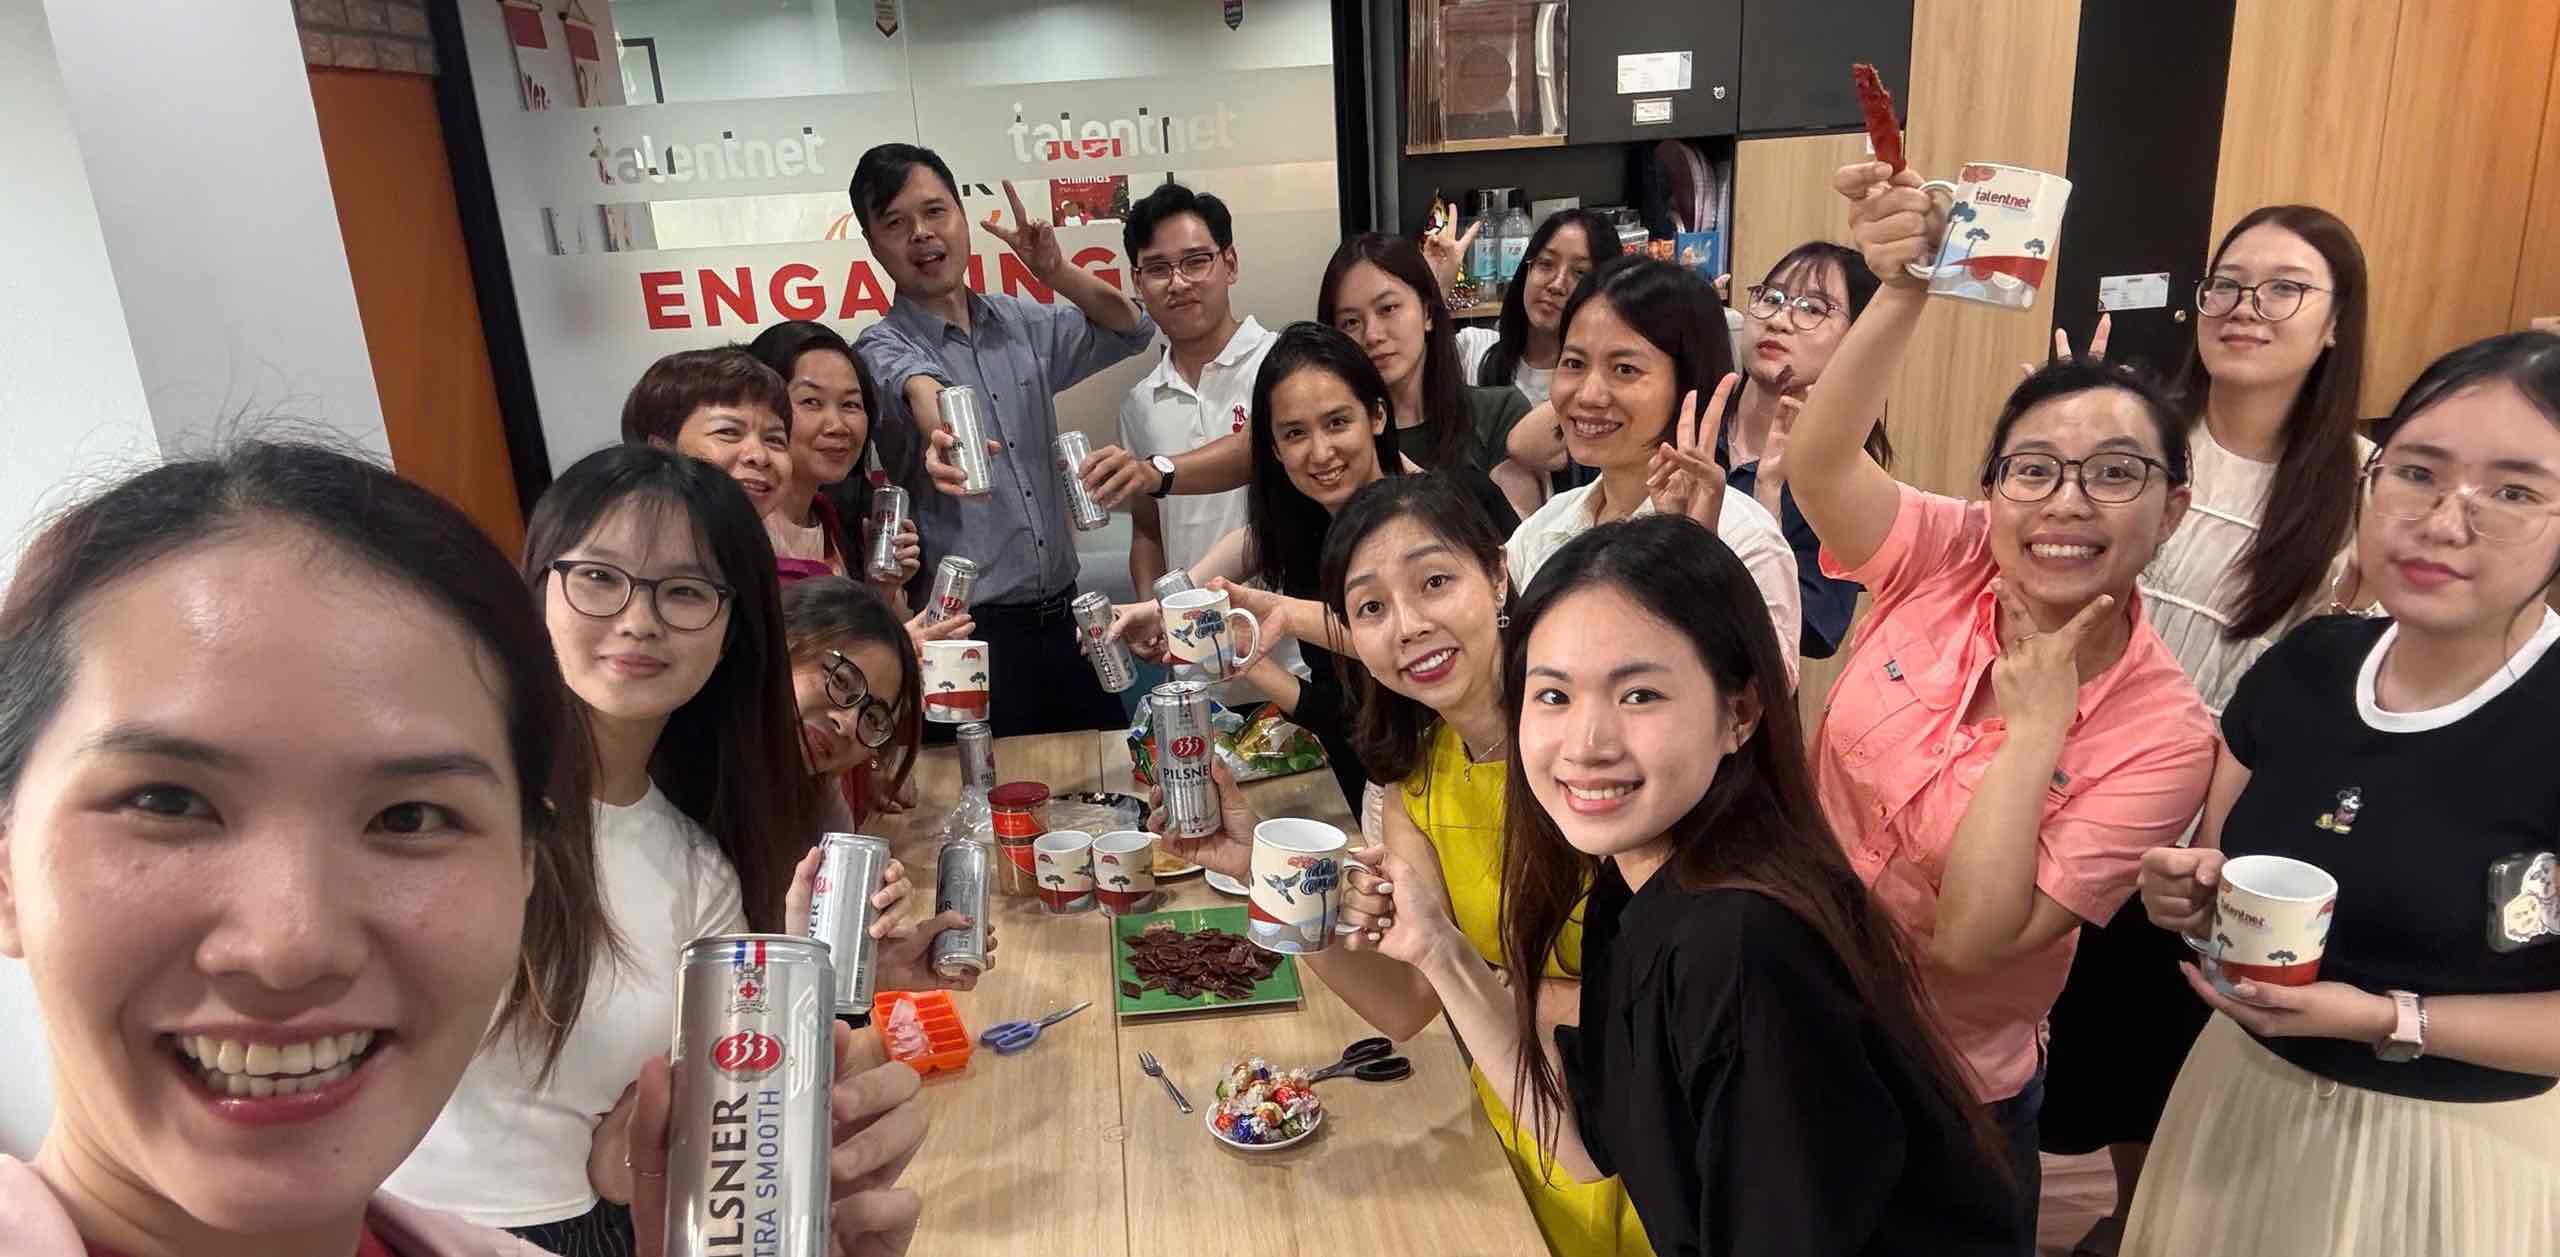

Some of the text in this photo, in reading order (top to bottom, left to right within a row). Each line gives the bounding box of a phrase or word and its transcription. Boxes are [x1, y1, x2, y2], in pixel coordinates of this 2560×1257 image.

[1006, 101, 1237, 163] talentnet
[1976, 187, 2031, 209] talentnet
[640, 246, 1123, 330] ENGAING
[1178, 736, 1201, 757] 333
[725, 1030, 768, 1067] 333
[756, 1090, 781, 1199] SMOOTH
